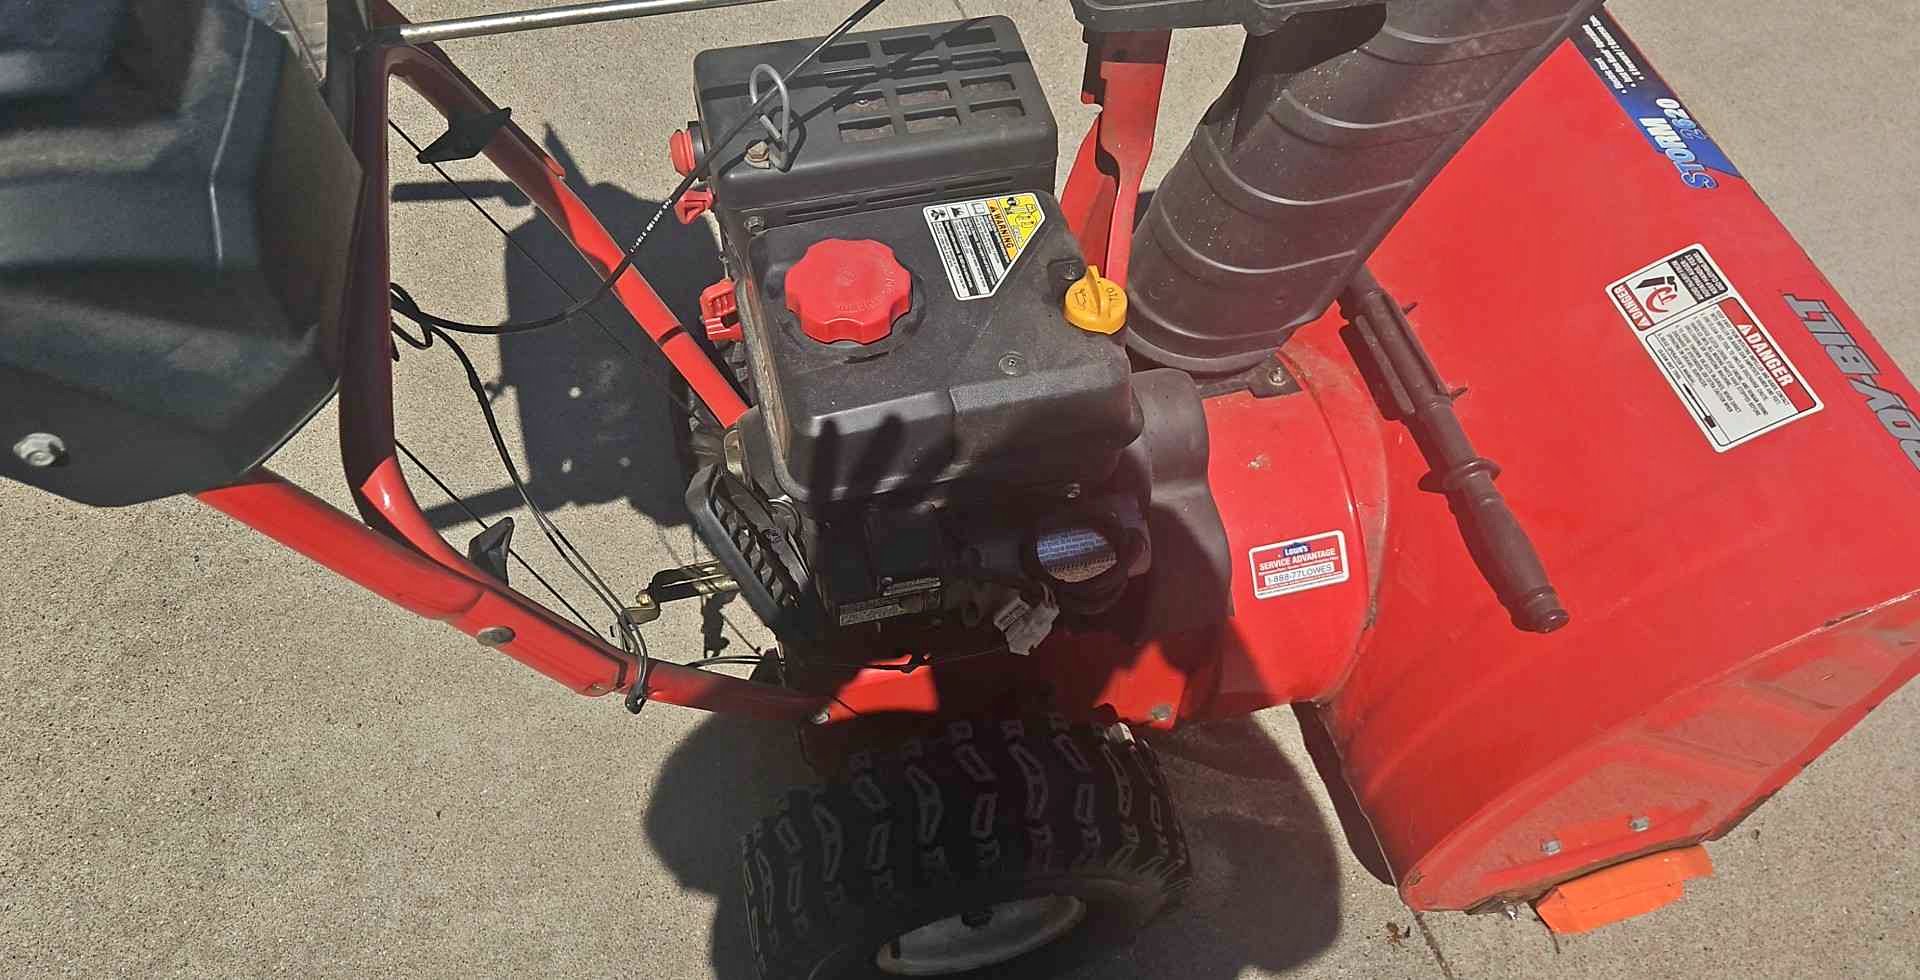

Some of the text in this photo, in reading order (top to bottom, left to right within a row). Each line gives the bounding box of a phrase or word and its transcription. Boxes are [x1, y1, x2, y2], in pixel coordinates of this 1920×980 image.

[1638, 116, 1717, 187] STORM
[992, 212, 1014, 249] WARNING
[1613, 284, 1643, 318] DANGER
[1745, 333, 1794, 387] DANGER
[1258, 557, 1290, 571] SERVICE
[1292, 547, 1336, 563] ADVANTAGE
[1267, 563, 1332, 584] 1-888-77LOWES
